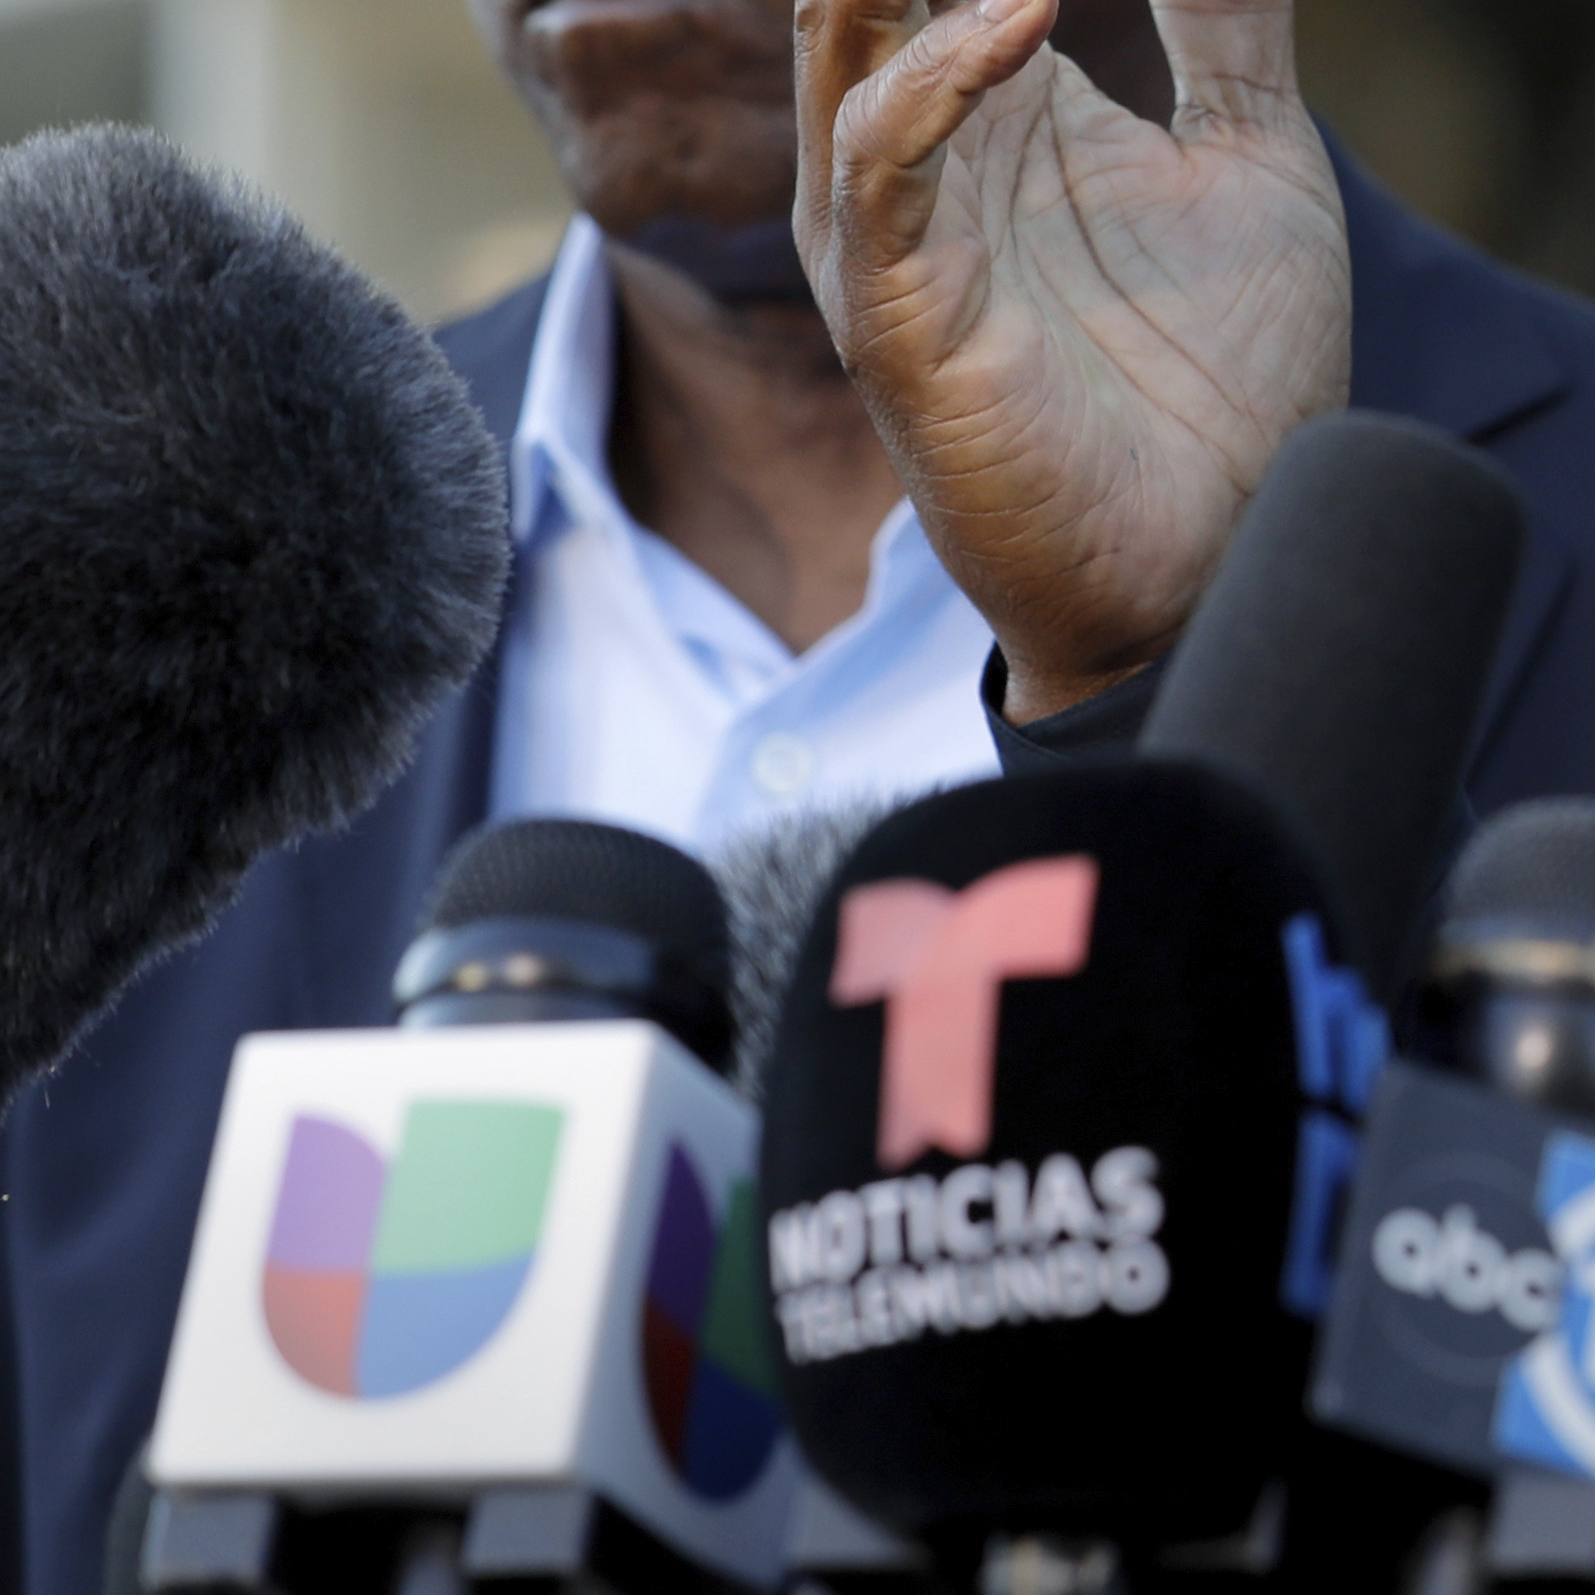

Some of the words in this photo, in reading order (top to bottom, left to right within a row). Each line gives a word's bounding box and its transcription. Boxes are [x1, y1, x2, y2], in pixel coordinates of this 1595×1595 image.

[768, 1145, 1166, 1294] NOTICIAS
[1371, 1203, 1565, 1331] abc
[776, 1238, 1170, 1363] TELEMUNDO
